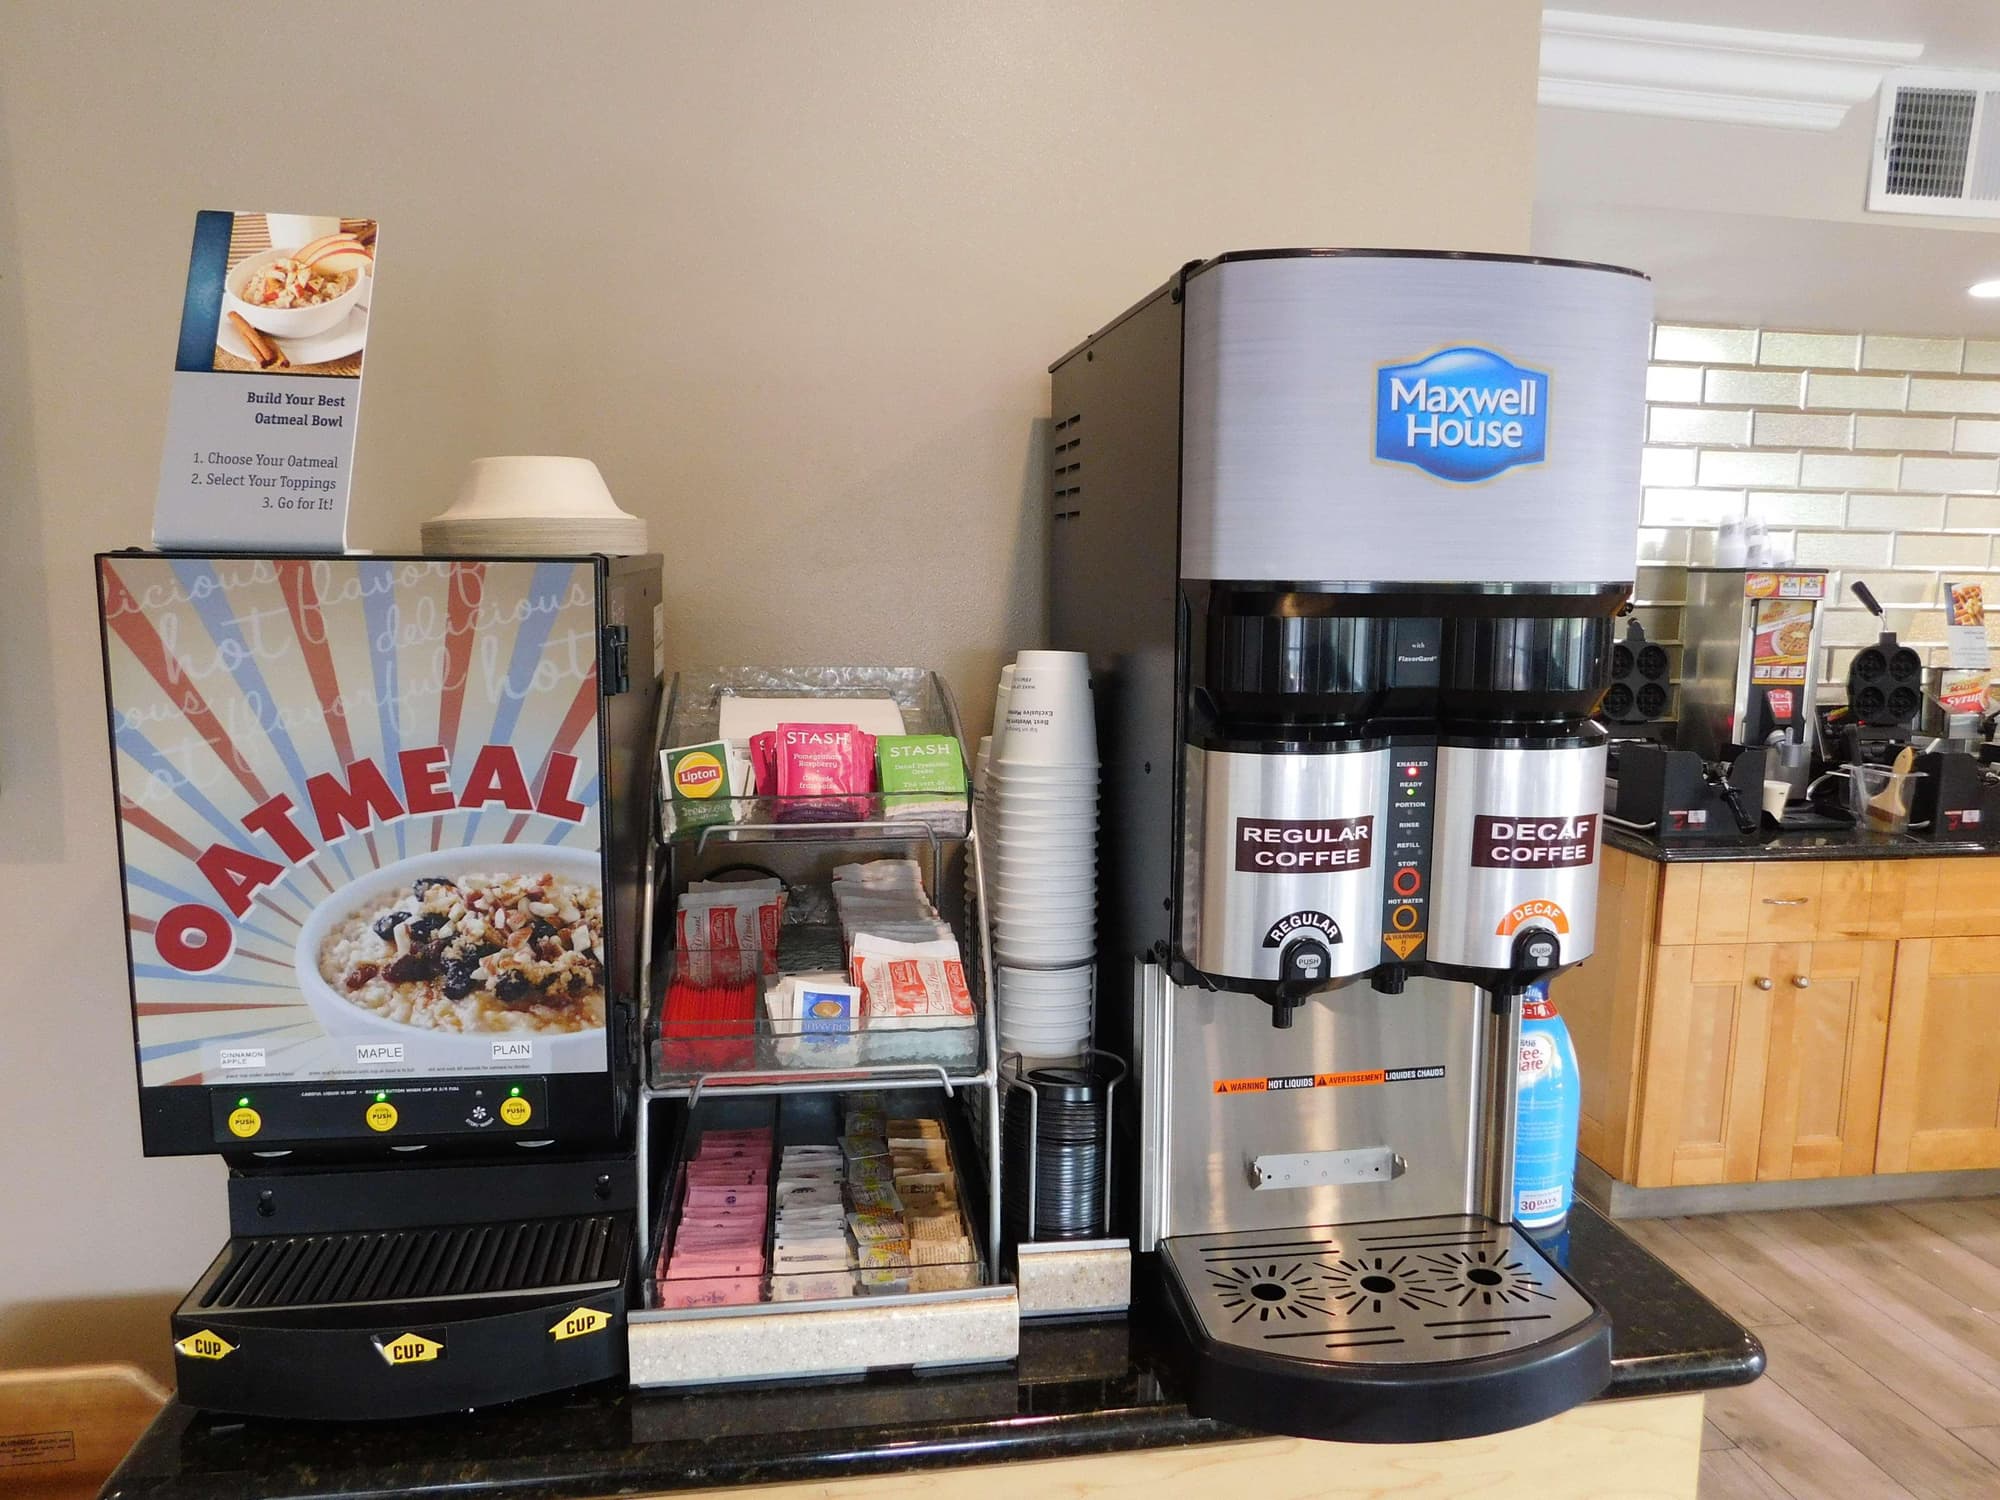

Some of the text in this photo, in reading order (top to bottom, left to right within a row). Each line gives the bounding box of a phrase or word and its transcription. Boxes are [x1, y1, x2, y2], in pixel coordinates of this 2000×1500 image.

[247, 392, 345, 407] Build Your Best
[1390, 378, 1536, 417] Maxwell
[255, 413, 343, 427] Oatmeal Bowl
[1406, 414, 1523, 448] House
[193, 452, 338, 469] 1. Choose Your Oatmeal
[191, 473, 336, 492] 2. Select Your Toppings
[262, 497, 333, 511] 3. Go for It!
[160, 583, 596, 704] hot delicious hot
[787, 731, 849, 745] STASH
[890, 743, 950, 757] STASH
[681, 769, 717, 783] Lipton
[1244, 825, 1369, 844] REGULAR
[1490, 820, 1589, 841] DECAF
[154, 744, 587, 975] OATMEAL
[1254, 848, 1360, 866] COFFEE
[1490, 844, 1587, 861] COFFEE
[1512, 902, 1560, 921] DECAF
[1271, 913, 1338, 941] REGULAR
[358, 1047, 402, 1059] MAPLE
[493, 1044, 530, 1055] PLAIN
[1230, 1067, 1444, 1091] WARNING HOT LIQUIDS AVERTISSEMENT LIQUIDES CHAUDS
[1521, 1200, 1536, 1211] 30
[566, 1316, 596, 1335] CUP
[195, 1338, 221, 1356] CUP
[393, 1343, 425, 1360] CUP
